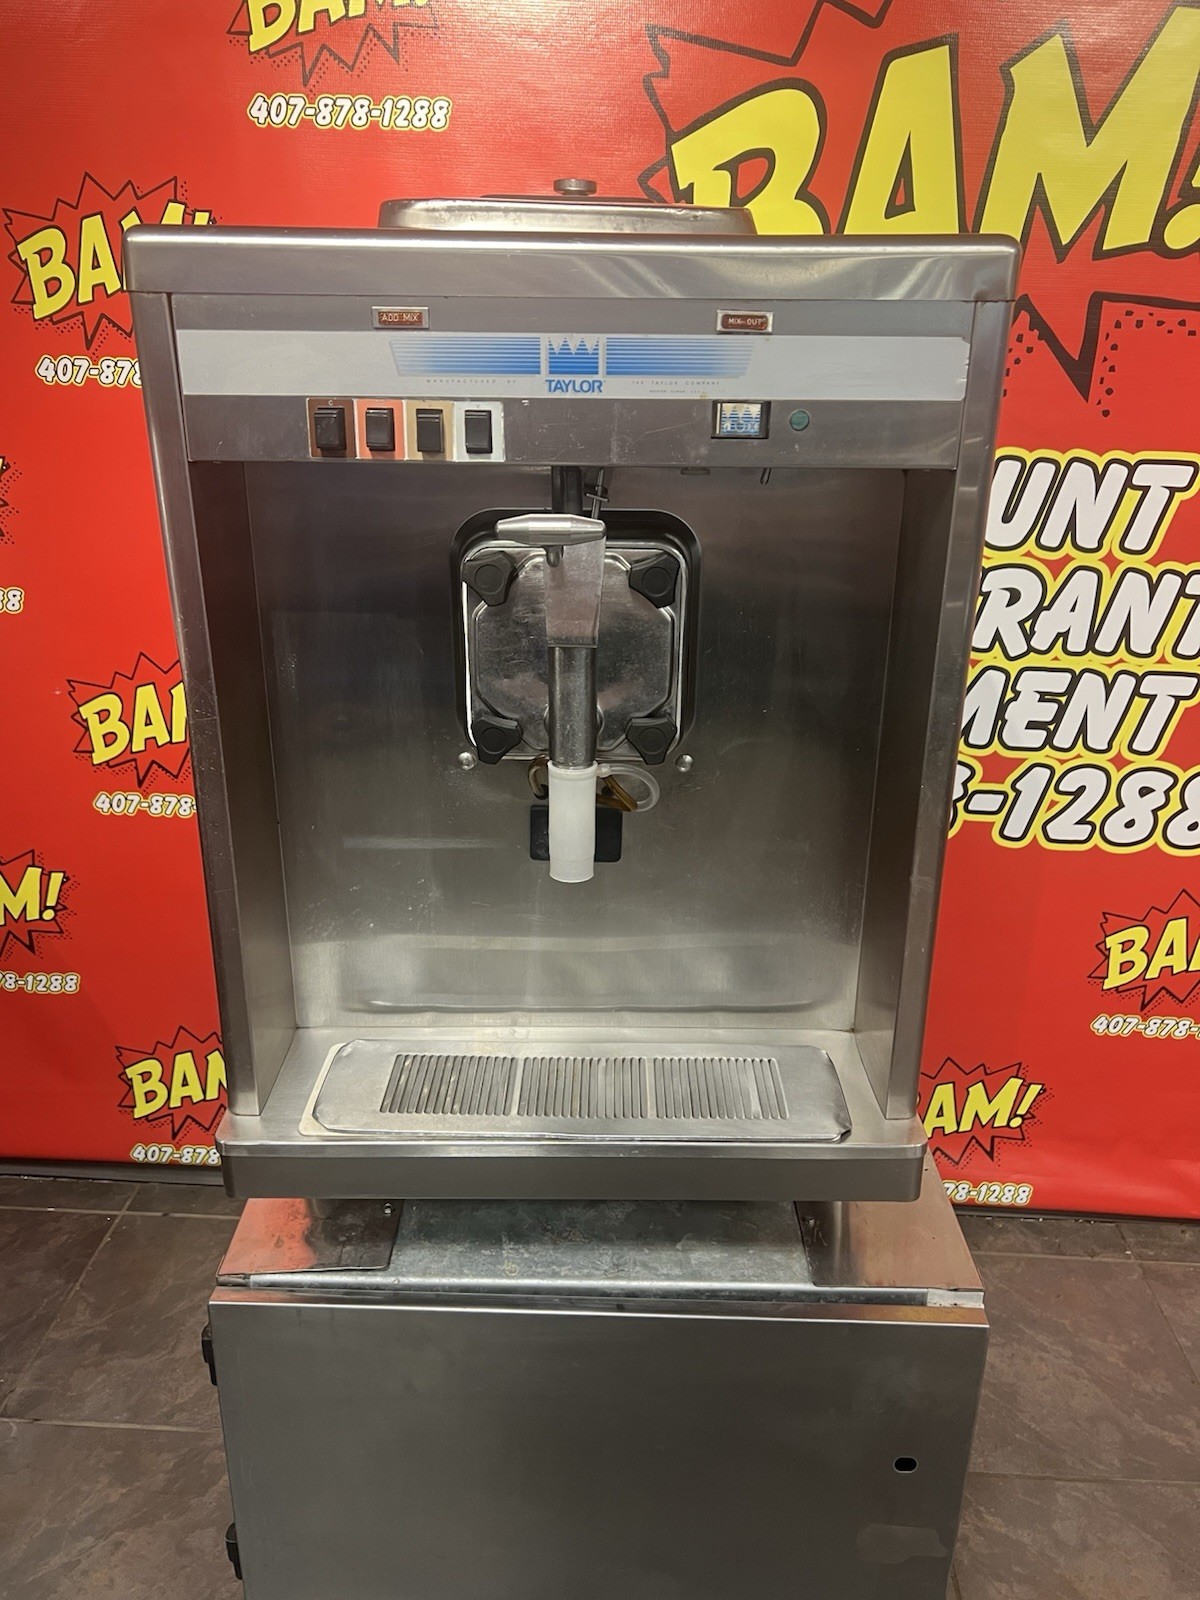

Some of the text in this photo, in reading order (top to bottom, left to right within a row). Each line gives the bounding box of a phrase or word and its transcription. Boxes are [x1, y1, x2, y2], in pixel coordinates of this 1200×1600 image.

[249, 94, 450, 130] 407-878-1288
[380, 312, 420, 322] ADD MIX
[545, 379, 604, 394] TAYLOR
[985, 455, 1199, 555] UNT
[1102, 917, 1200, 990] BA
[0, 972, 80, 993] 8-1288
[1092, 1015, 1200, 1038] 407-878-
[919, 1076, 1044, 1139] AM!
[131, 1145, 221, 1165] 407-878
[943, 1181, 1032, 1205] 78-1288
